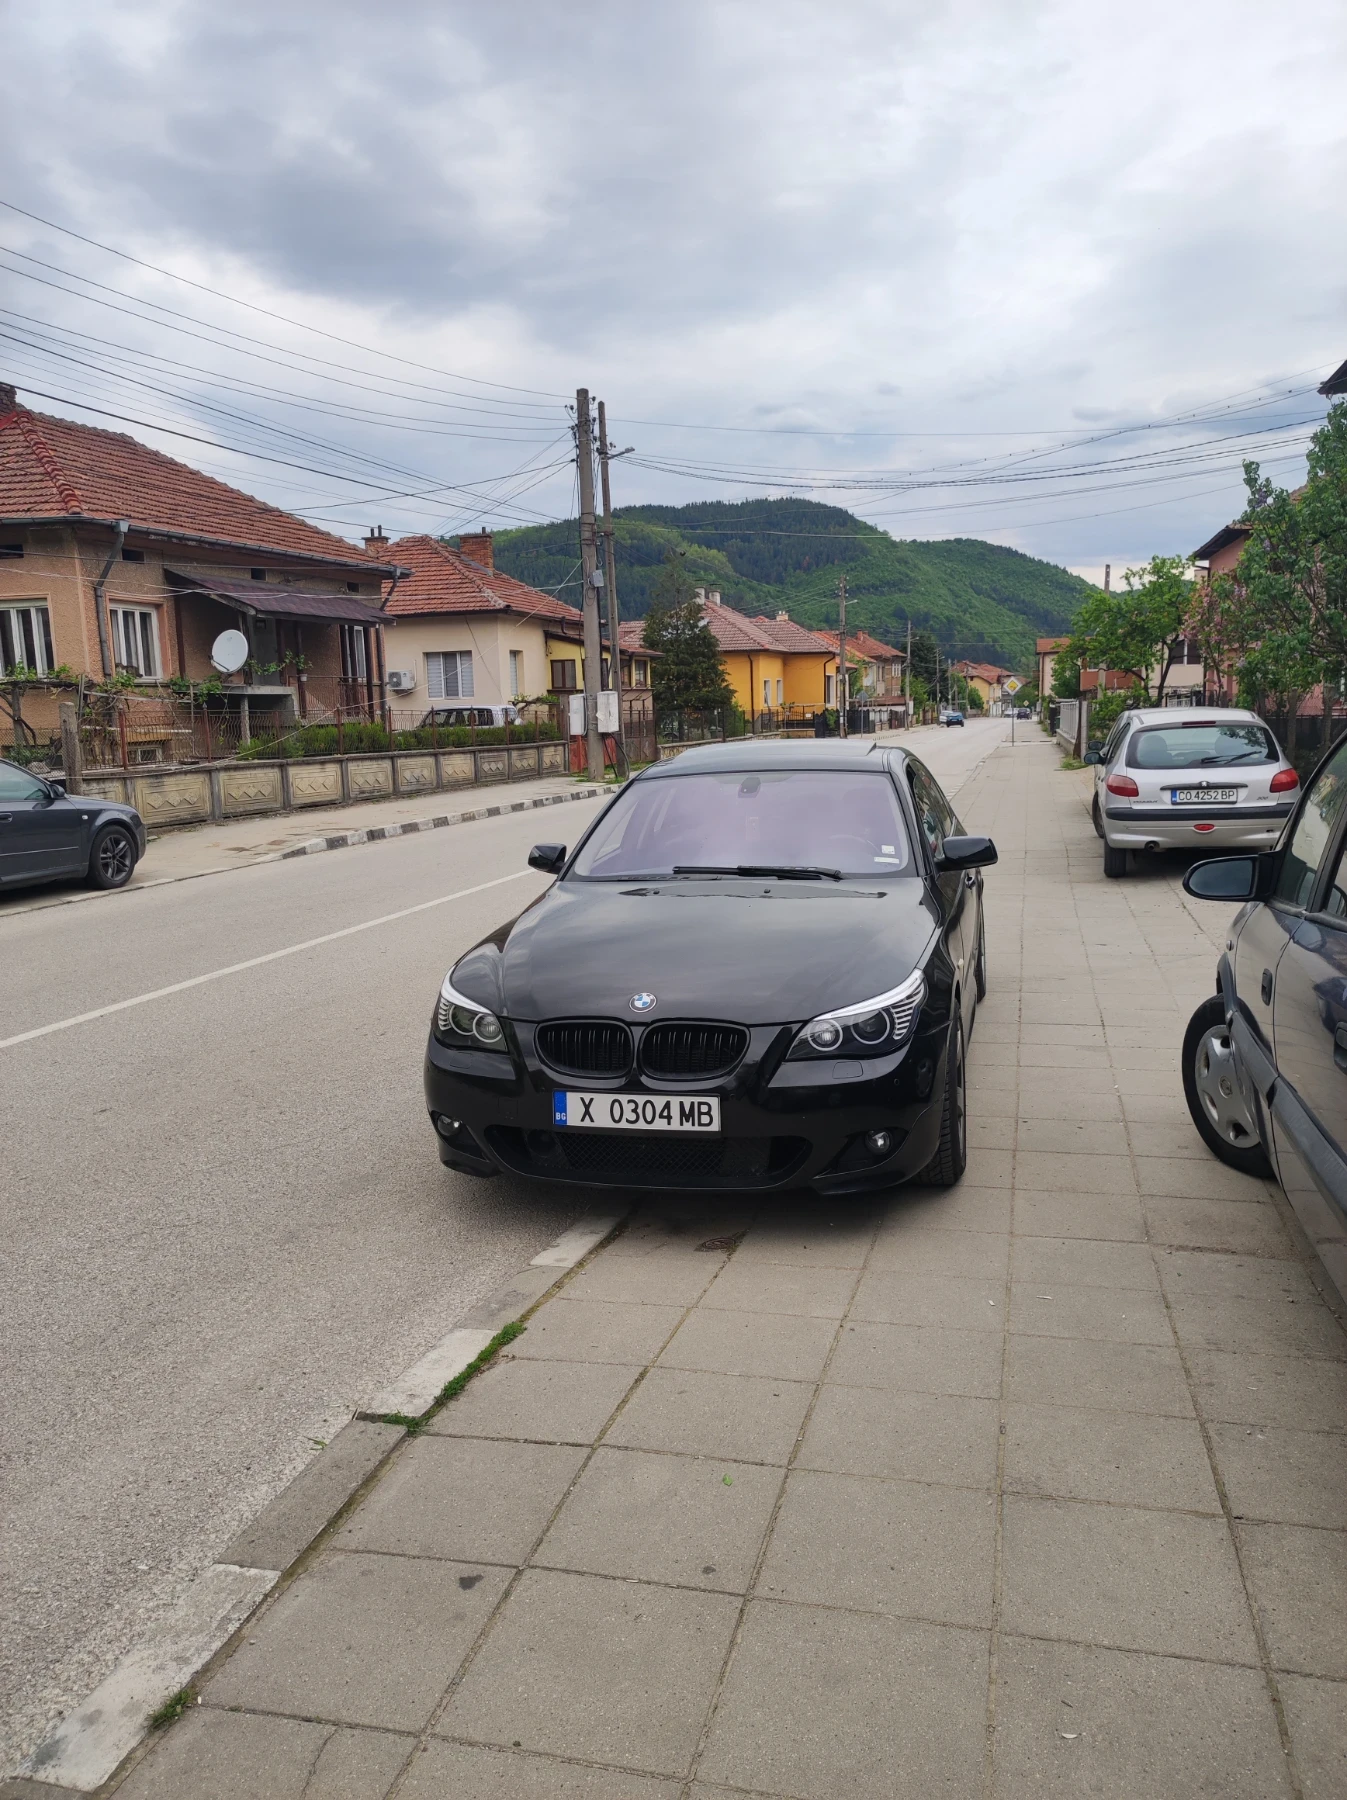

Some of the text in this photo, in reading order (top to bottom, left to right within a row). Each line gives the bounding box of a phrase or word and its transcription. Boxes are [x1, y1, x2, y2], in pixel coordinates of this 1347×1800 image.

[1193, 790, 1219, 801] 4252
[1221, 790, 1235, 800] BP
[555, 1112, 567, 1121] BG
[579, 1096, 714, 1127] X 0304 MB
